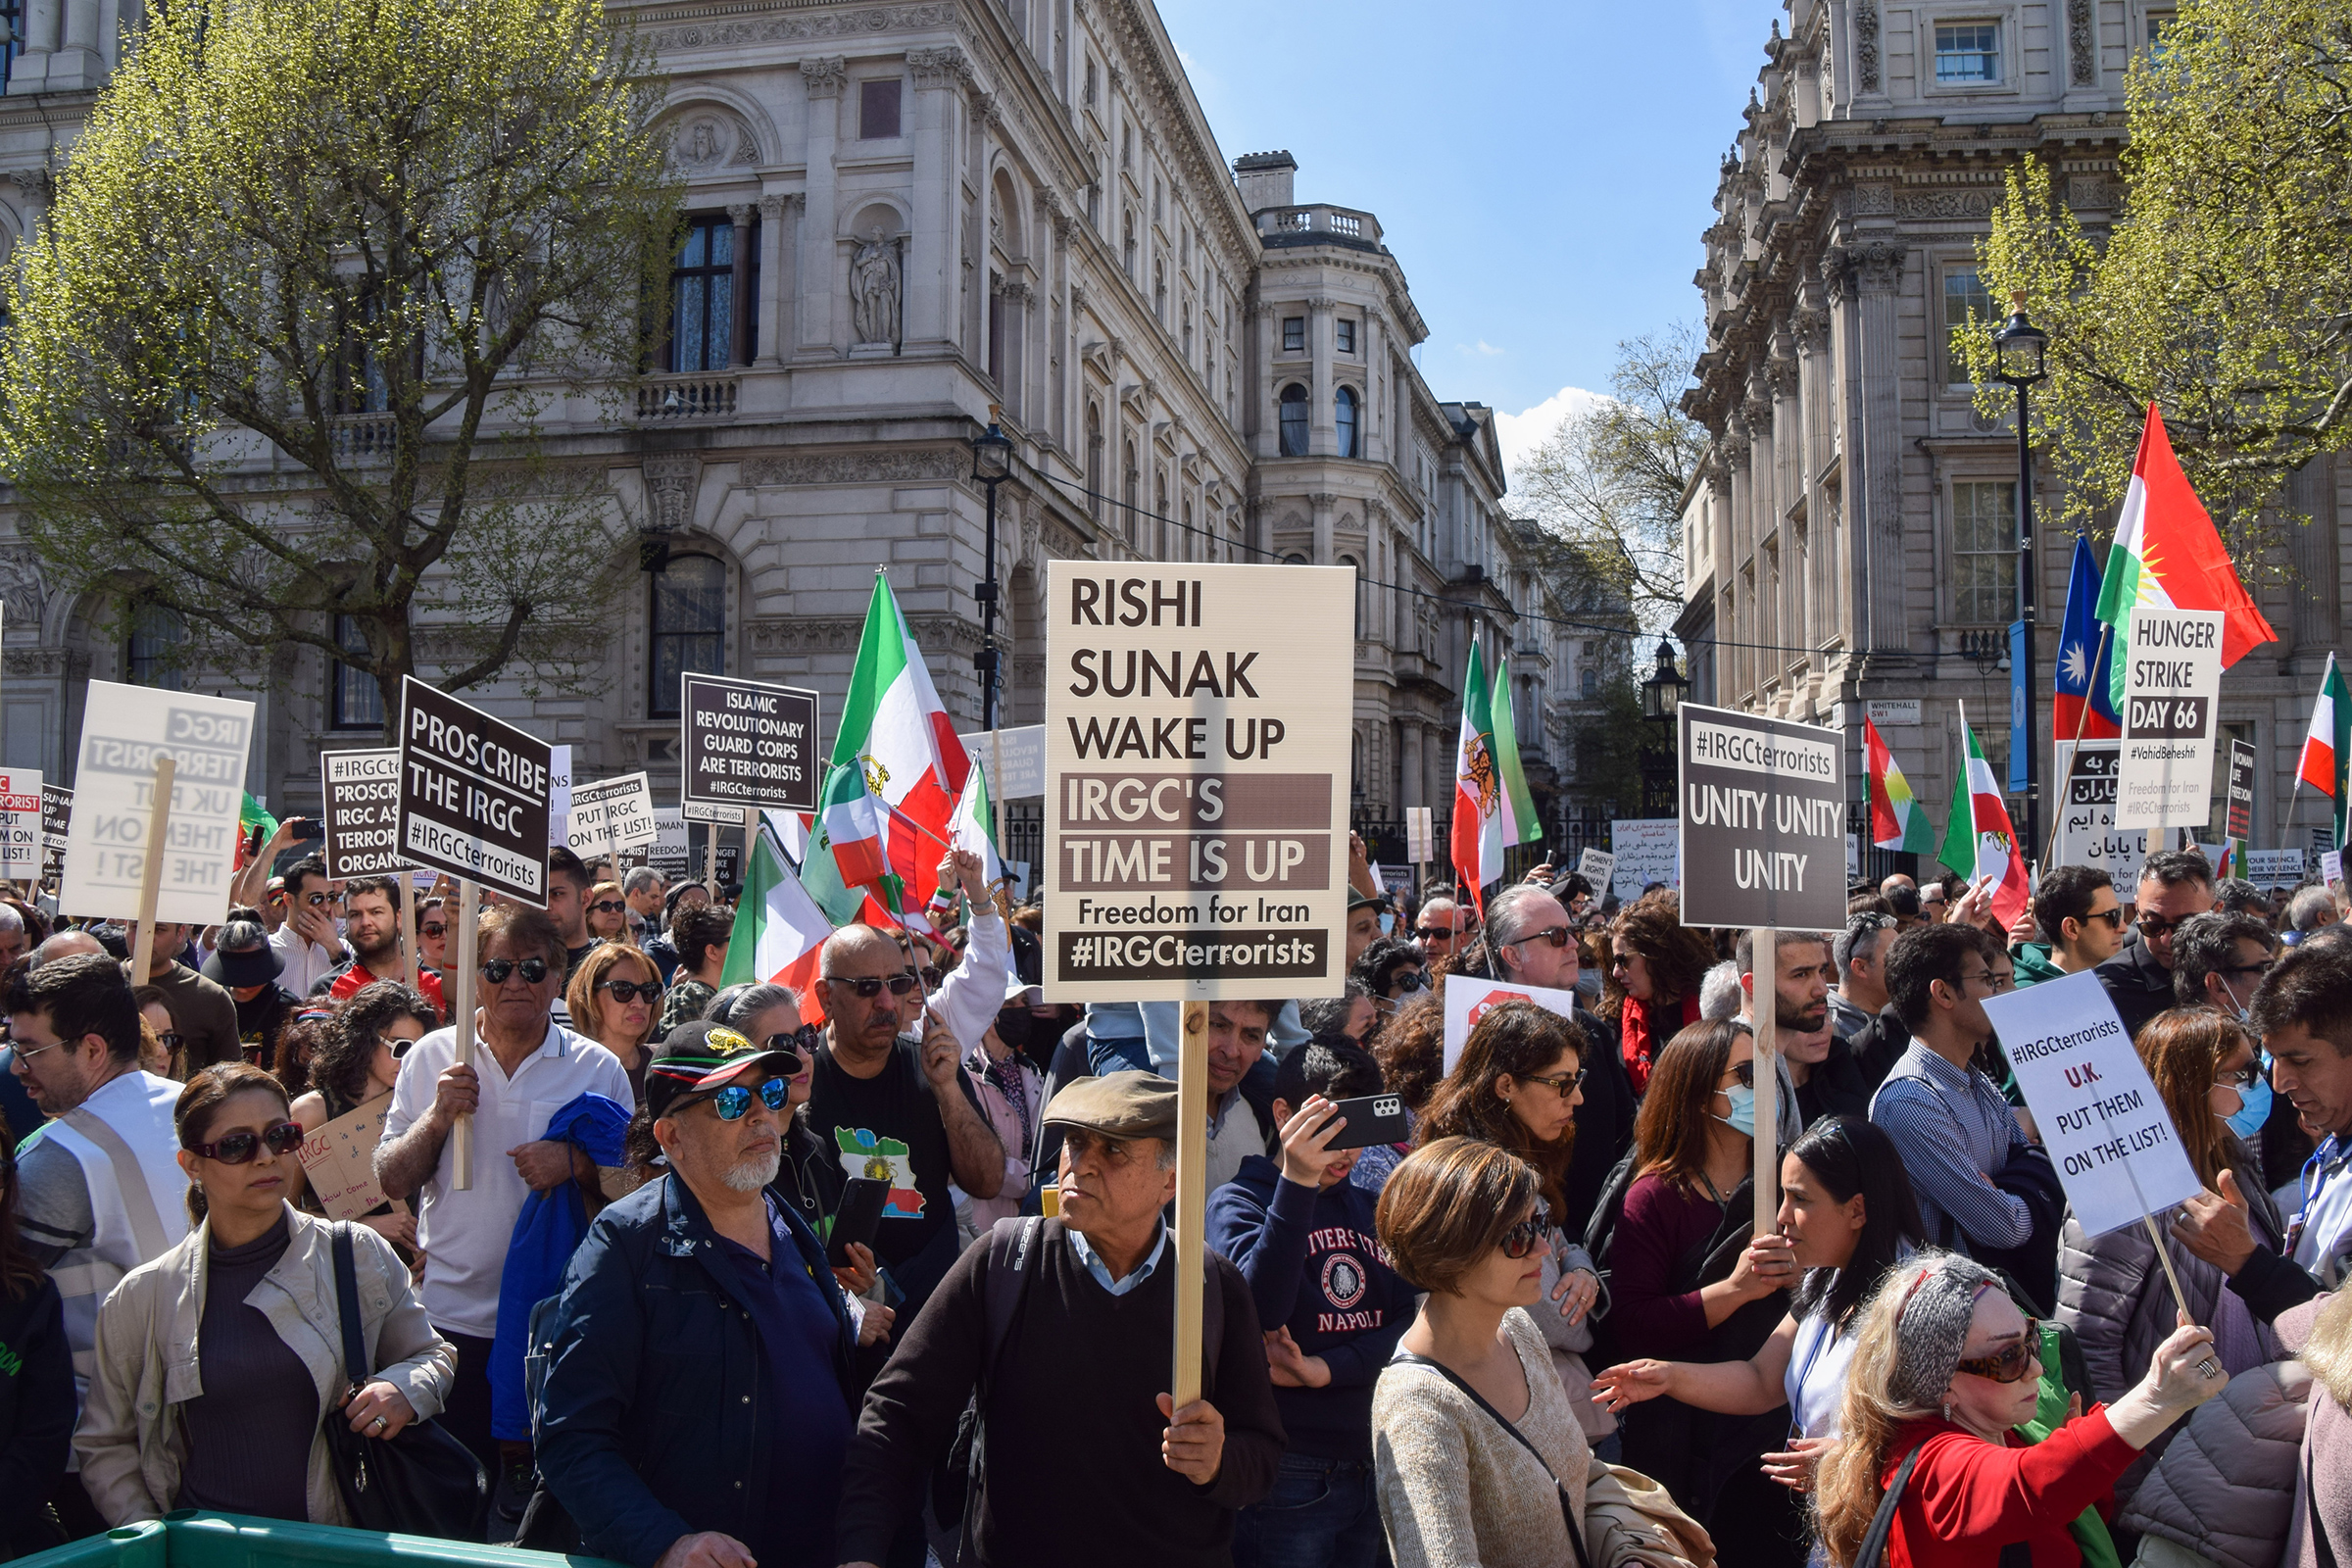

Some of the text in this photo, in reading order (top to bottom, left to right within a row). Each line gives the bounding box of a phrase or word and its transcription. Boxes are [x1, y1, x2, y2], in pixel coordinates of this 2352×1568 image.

[1071, 578, 1202, 627] RISHI
[2137, 619, 2215, 649] HUNGER
[1069, 648, 1260, 699] SUNAK
[2134, 660, 2193, 688] STRIKE
[726, 692, 777, 714] ISLAMIC
[2131, 701, 2197, 729] DAY 66
[696, 710, 805, 739] REVOLUTIONARY
[1066, 716, 1286, 760] WAKE UP
[411, 707, 546, 798] PROSCRIBE
[704, 734, 798, 760] GUARD CORPS
[1696, 730, 1831, 776] #IRGCterrorists
[2131, 745, 2196, 760] #VahidBeheshti
[2233, 751, 2253, 768] WOMAN
[699, 756, 802, 782] ARE TERRORISTS
[408, 760, 523, 839] THE IRGC
[710, 780, 787, 799] #IRGCterrorists
[1066, 777, 1224, 822] IRGC'S
[2129, 780, 2199, 795] Freedom for Iran
[43, 804, 58, 815] UP
[335, 807, 375, 826] IRGC
[576, 800, 638, 826] PUT IRGC
[687, 805, 742, 821] #IRGCterrorists
[1690, 782, 1842, 839] UNITY UNITY
[2127, 800, 2191, 815] #IRGCterrorists
[44, 816, 66, 829] TIME
[568, 829, 593, 849] ON
[595, 823, 621, 843] THE
[624, 816, 653, 835] LIST!
[655, 821, 684, 830] OMAN
[411, 821, 535, 886] #IRGCterrorists
[650, 845, 687, 856] REEDOM
[704, 849, 737, 858] HNGER
[1065, 838, 1305, 883] TIME IS UP
[2087, 837, 2131, 862] پایان
[1735, 848, 1808, 892] UNITY
[2118, 869, 2134, 880] for
[2113, 883, 2133, 893] Out
[1078, 895, 1310, 925] Freedom for Iran
[1070, 933, 1316, 968] #IRGCterrorists
[2012, 1020, 2120, 1065] #IRGCterrorists
[2064, 1062, 2103, 1089] U.K.
[2056, 1089, 2143, 1135] PUT THEM
[297, 1135, 332, 1164] IRGC
[2064, 1121, 2169, 1176] ON THE LIST!
[320, 1180, 368, 1205] How come
[1318, 1310, 1383, 1332] NAPOLI
